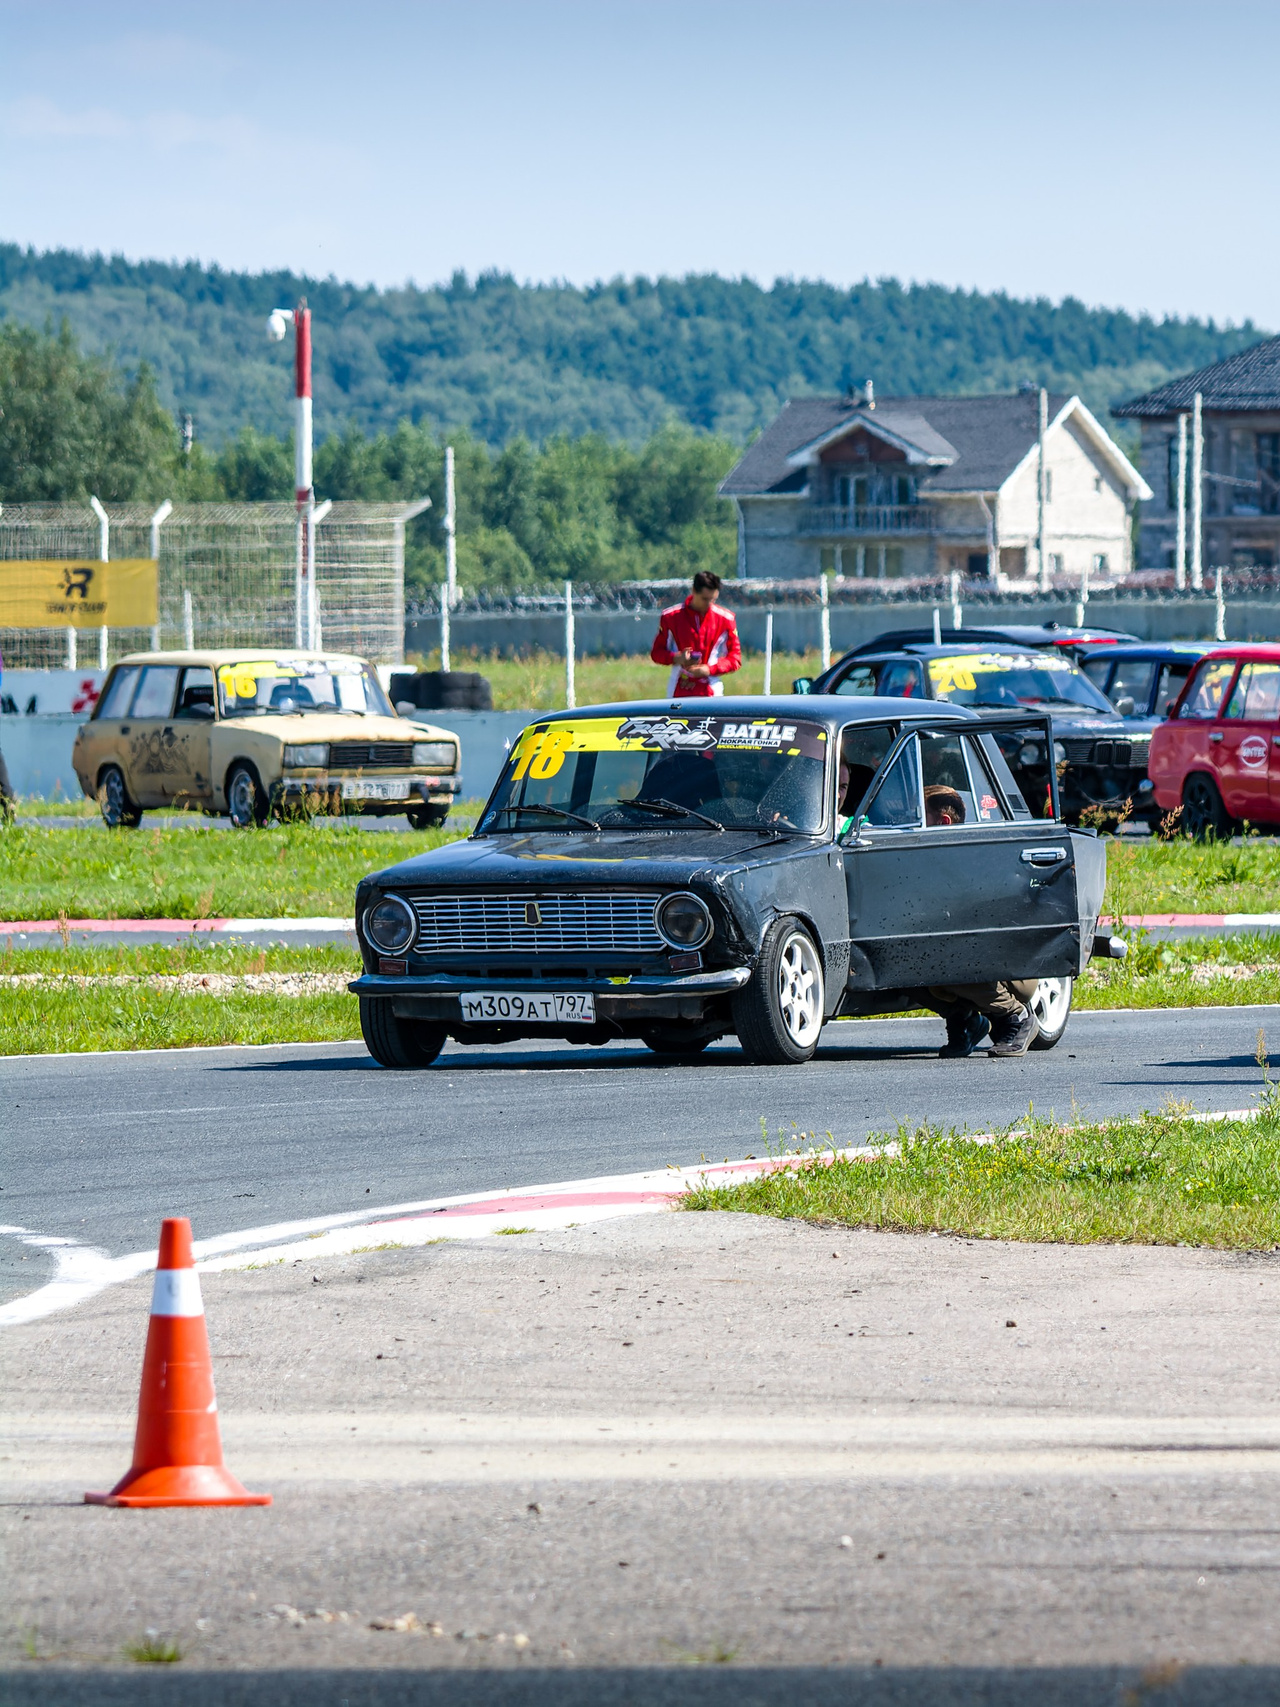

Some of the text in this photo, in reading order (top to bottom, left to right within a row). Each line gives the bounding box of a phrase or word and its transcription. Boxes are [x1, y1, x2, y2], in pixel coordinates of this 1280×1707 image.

[220, 675, 257, 699] 16
[931, 671, 977, 693] 20
[721, 723, 798, 741] BATTLE
[511, 731, 574, 781] 18
[556, 995, 586, 1012] 797
